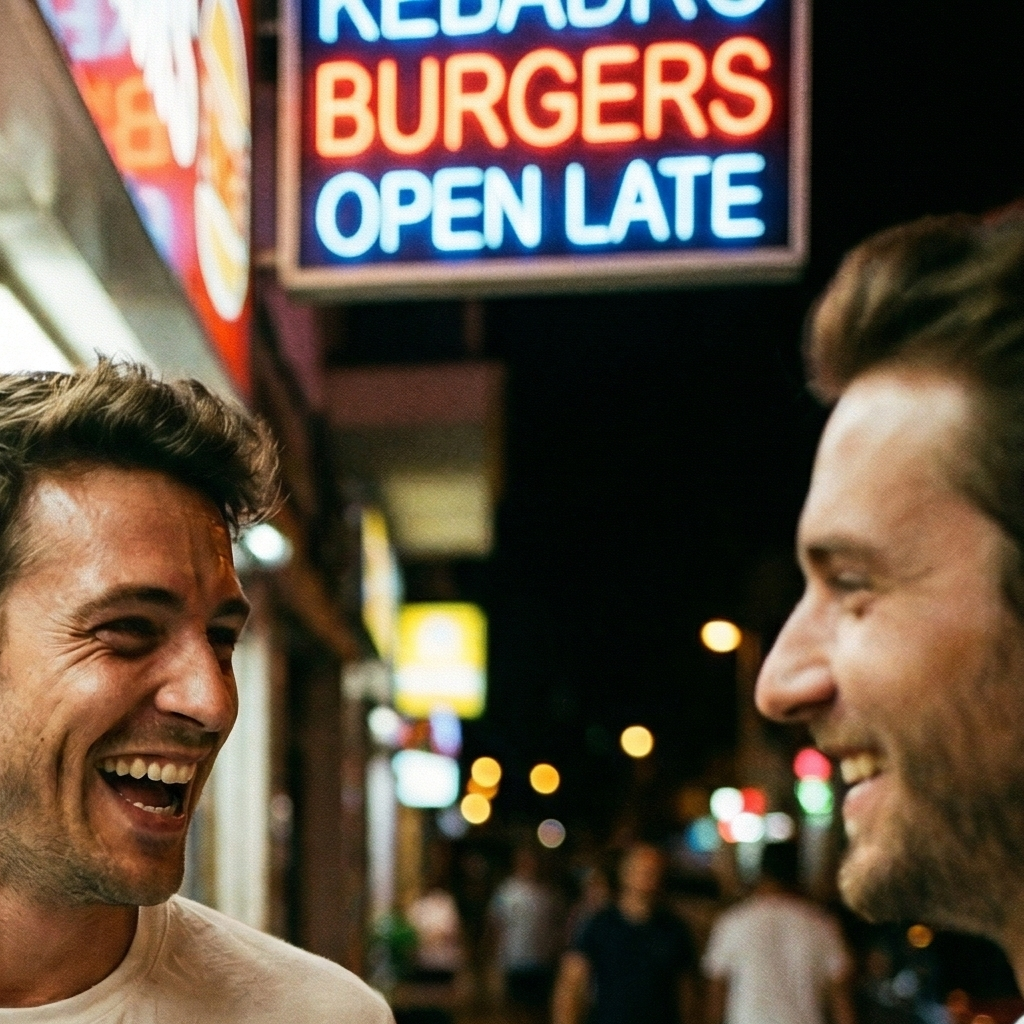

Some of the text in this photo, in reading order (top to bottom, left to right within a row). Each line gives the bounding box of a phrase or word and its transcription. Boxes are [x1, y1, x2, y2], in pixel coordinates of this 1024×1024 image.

[316, 36, 773, 157] BURGERS
[315, 152, 765, 258] OPEN LATE
